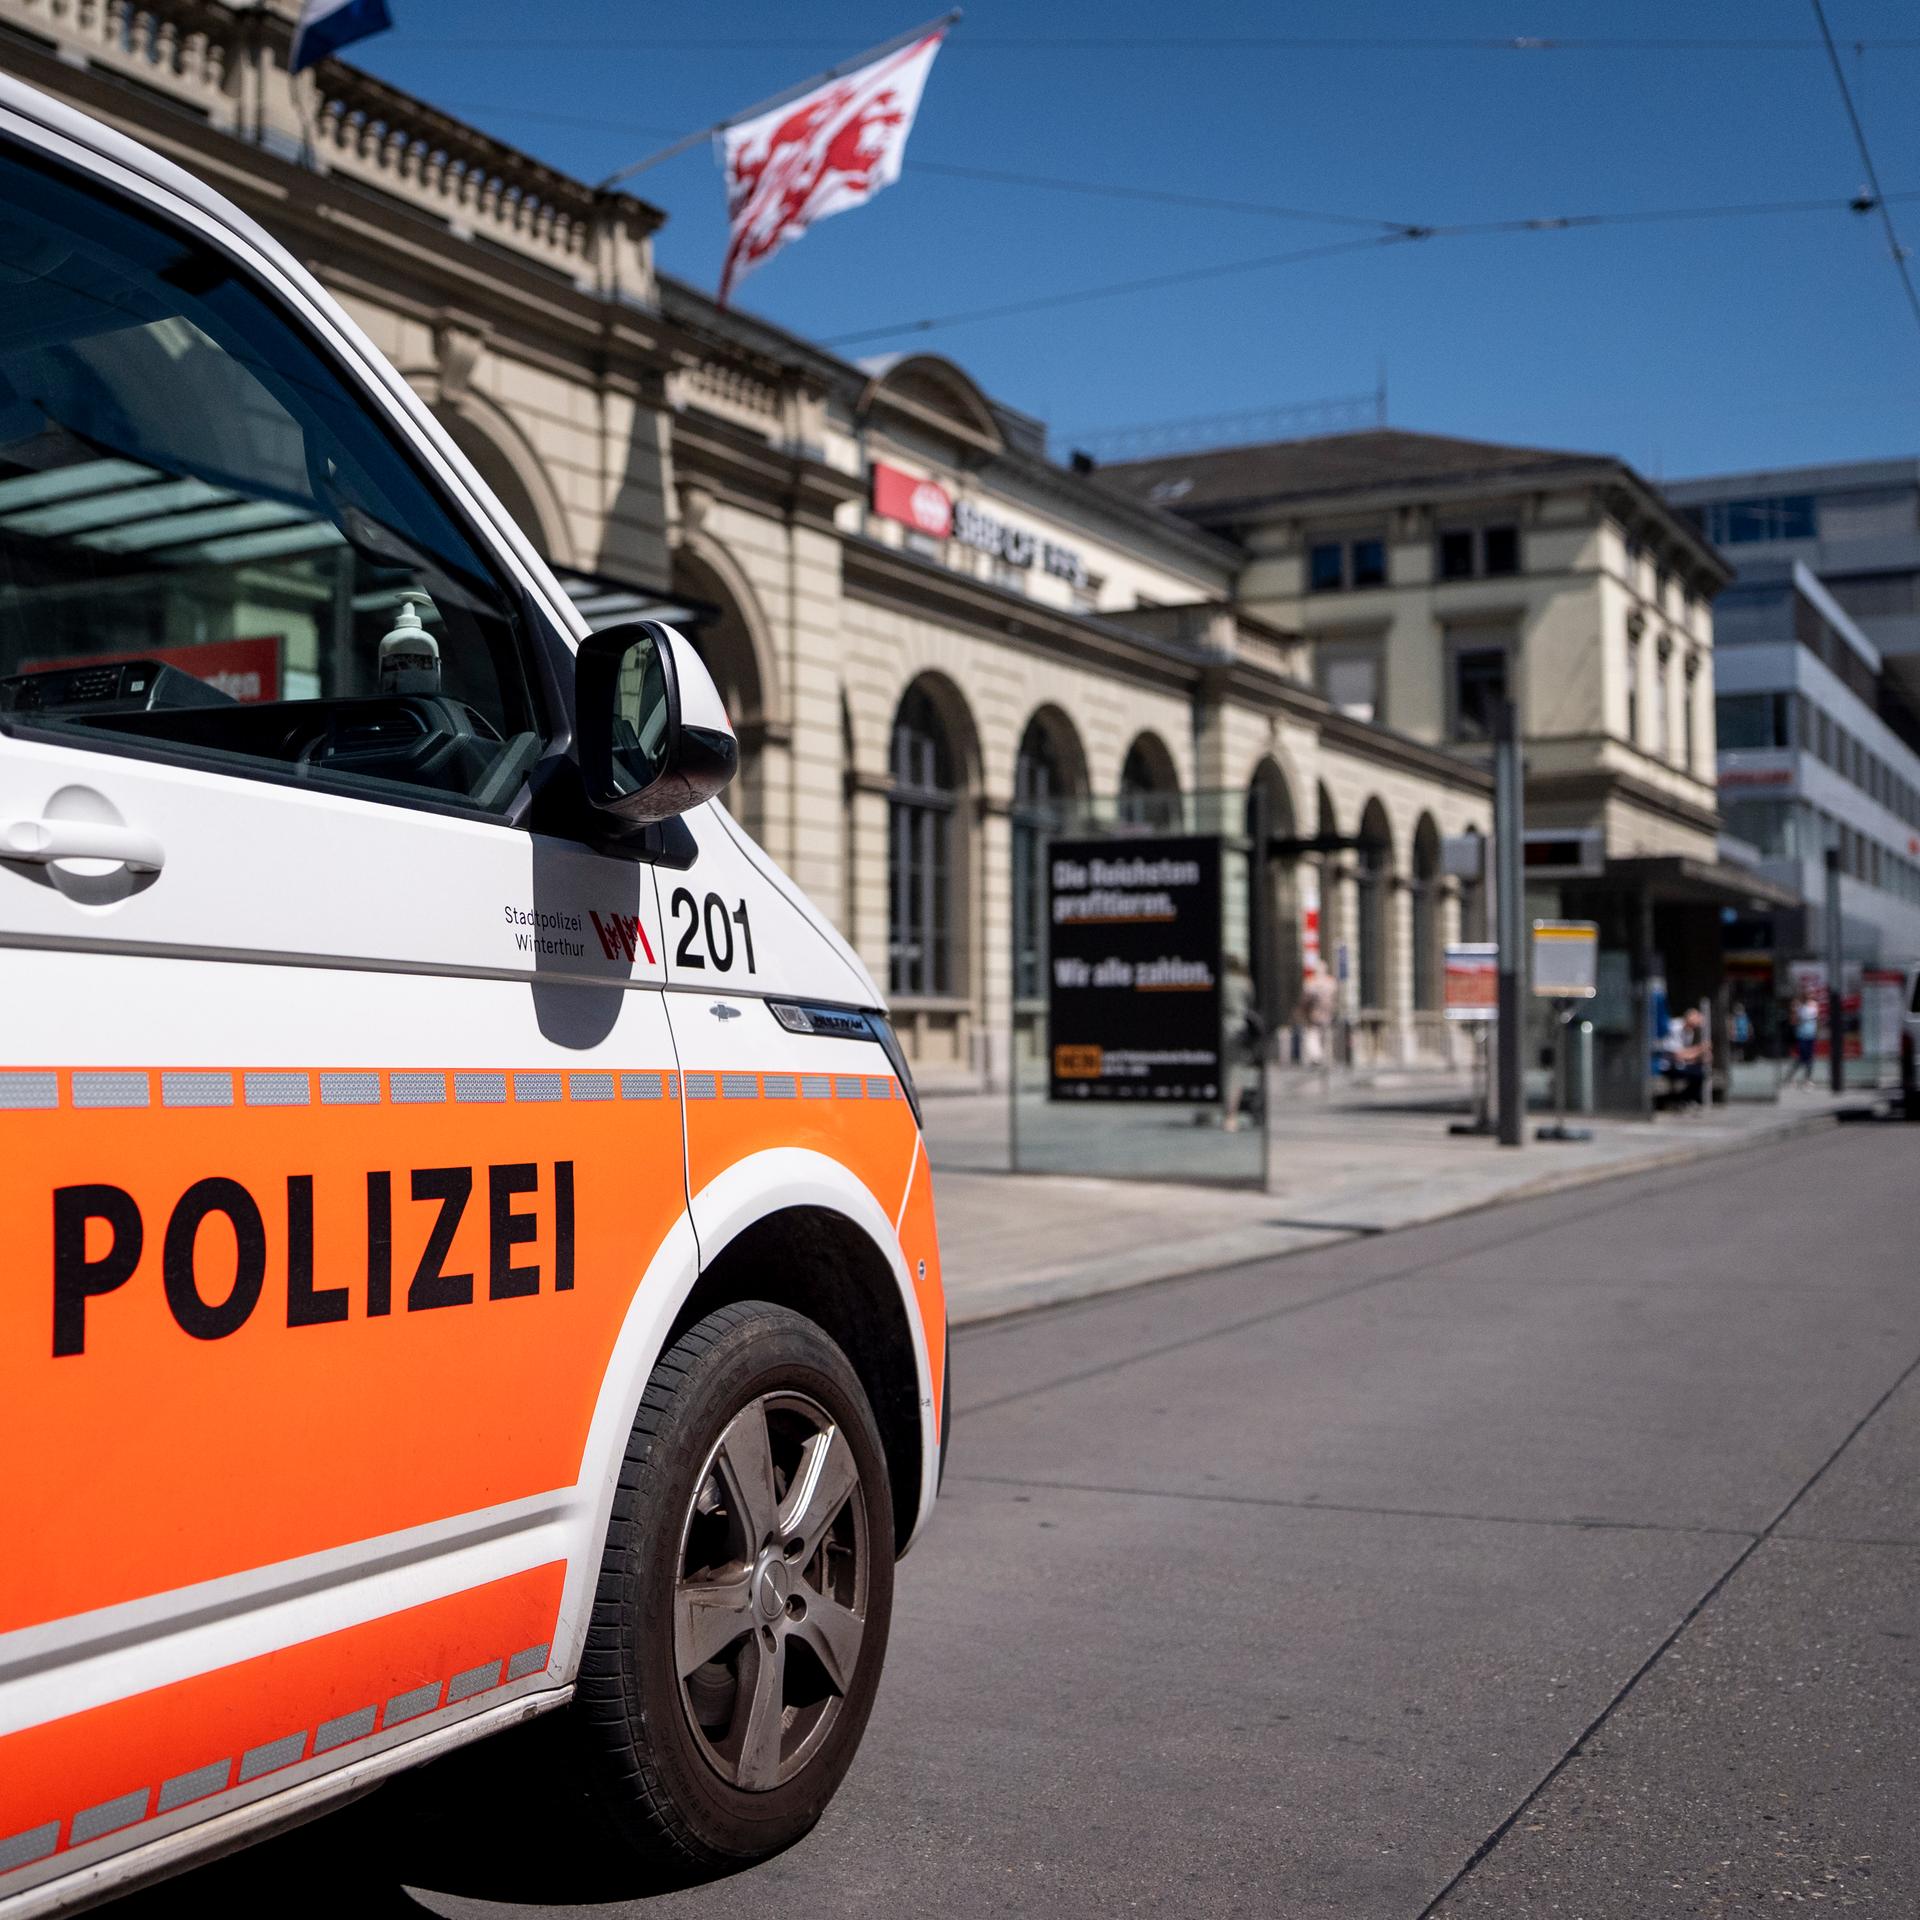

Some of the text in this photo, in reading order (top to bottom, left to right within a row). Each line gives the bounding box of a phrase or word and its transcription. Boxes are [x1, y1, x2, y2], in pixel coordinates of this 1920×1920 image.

[504, 905, 583, 932] Stadtpolizei
[515, 933, 585, 957] Winterthur
[671, 886, 756, 975] 201
[52, 1160, 575, 1358] POLIZEI
